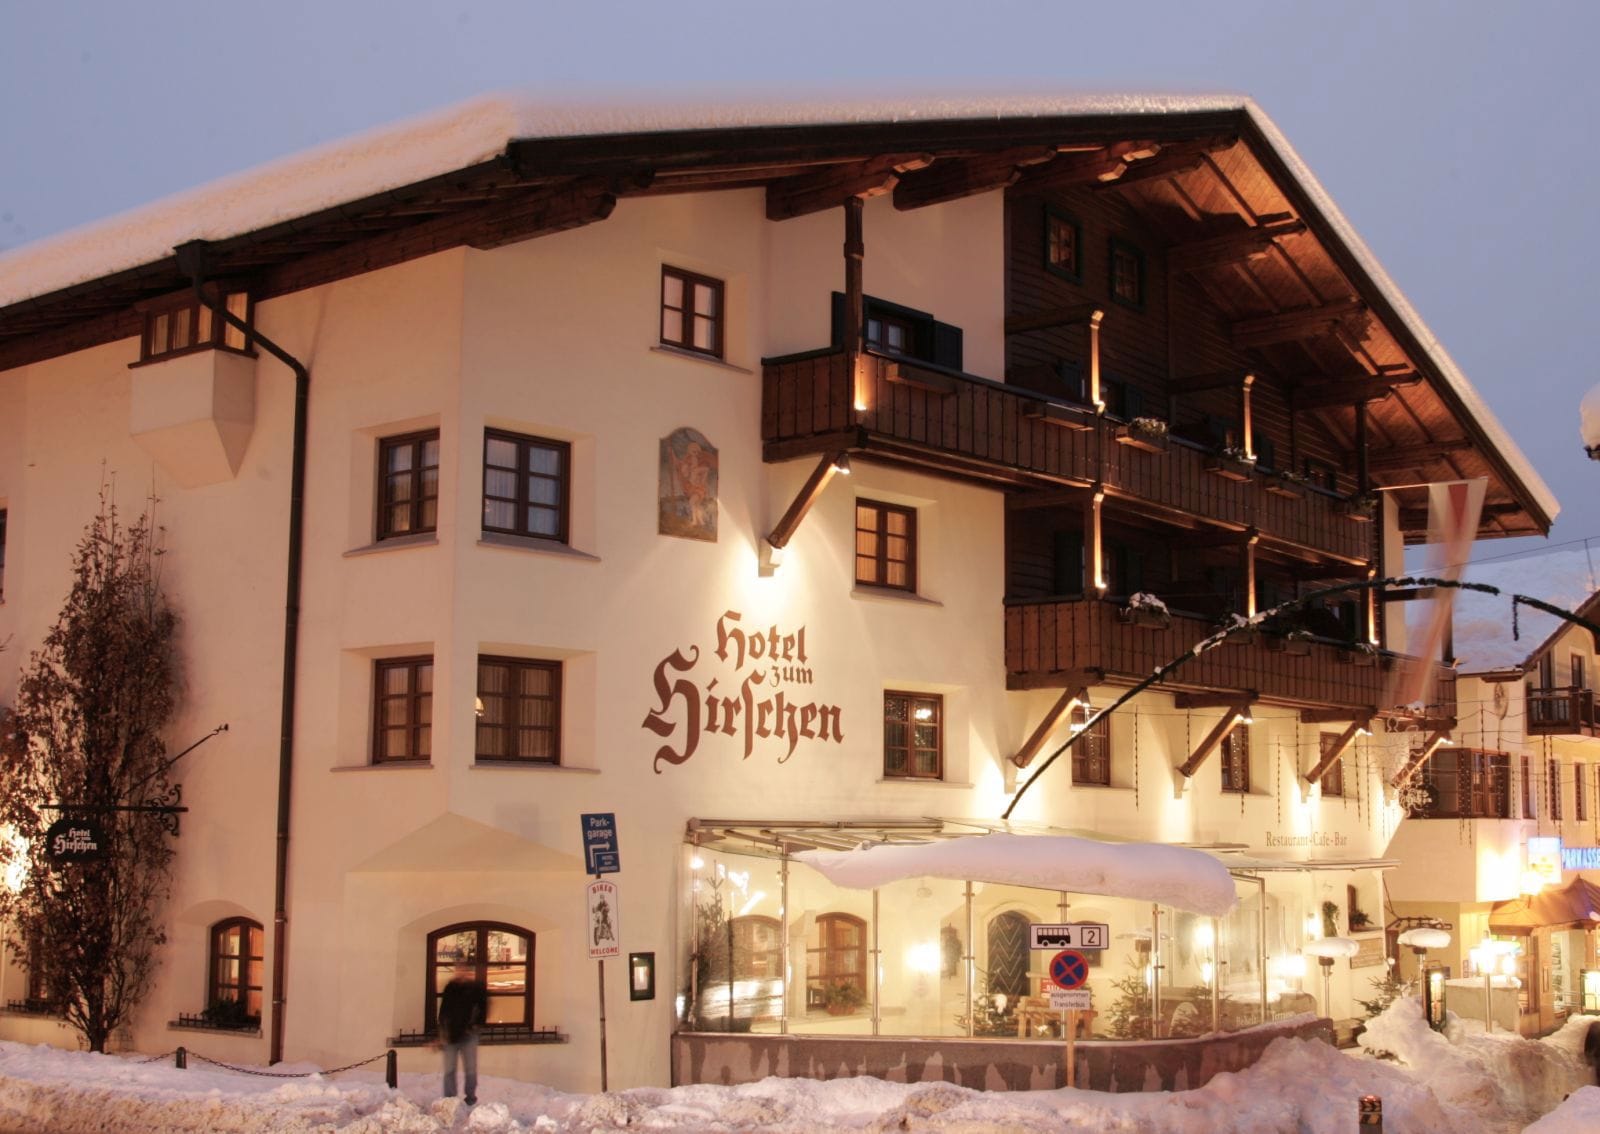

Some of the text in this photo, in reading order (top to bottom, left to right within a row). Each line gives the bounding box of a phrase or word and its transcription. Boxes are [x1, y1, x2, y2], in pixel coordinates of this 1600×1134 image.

[714, 609, 808, 671] Hotel
[770, 665, 813, 687] zum
[590, 817, 610, 827] Park-
[69, 827, 91, 839] Hotel
[587, 829, 612, 839] garage
[1266, 831, 1308, 847] Restaurant
[1088, 931, 1095, 943] 2
[591, 947, 618, 955] WELCOME
